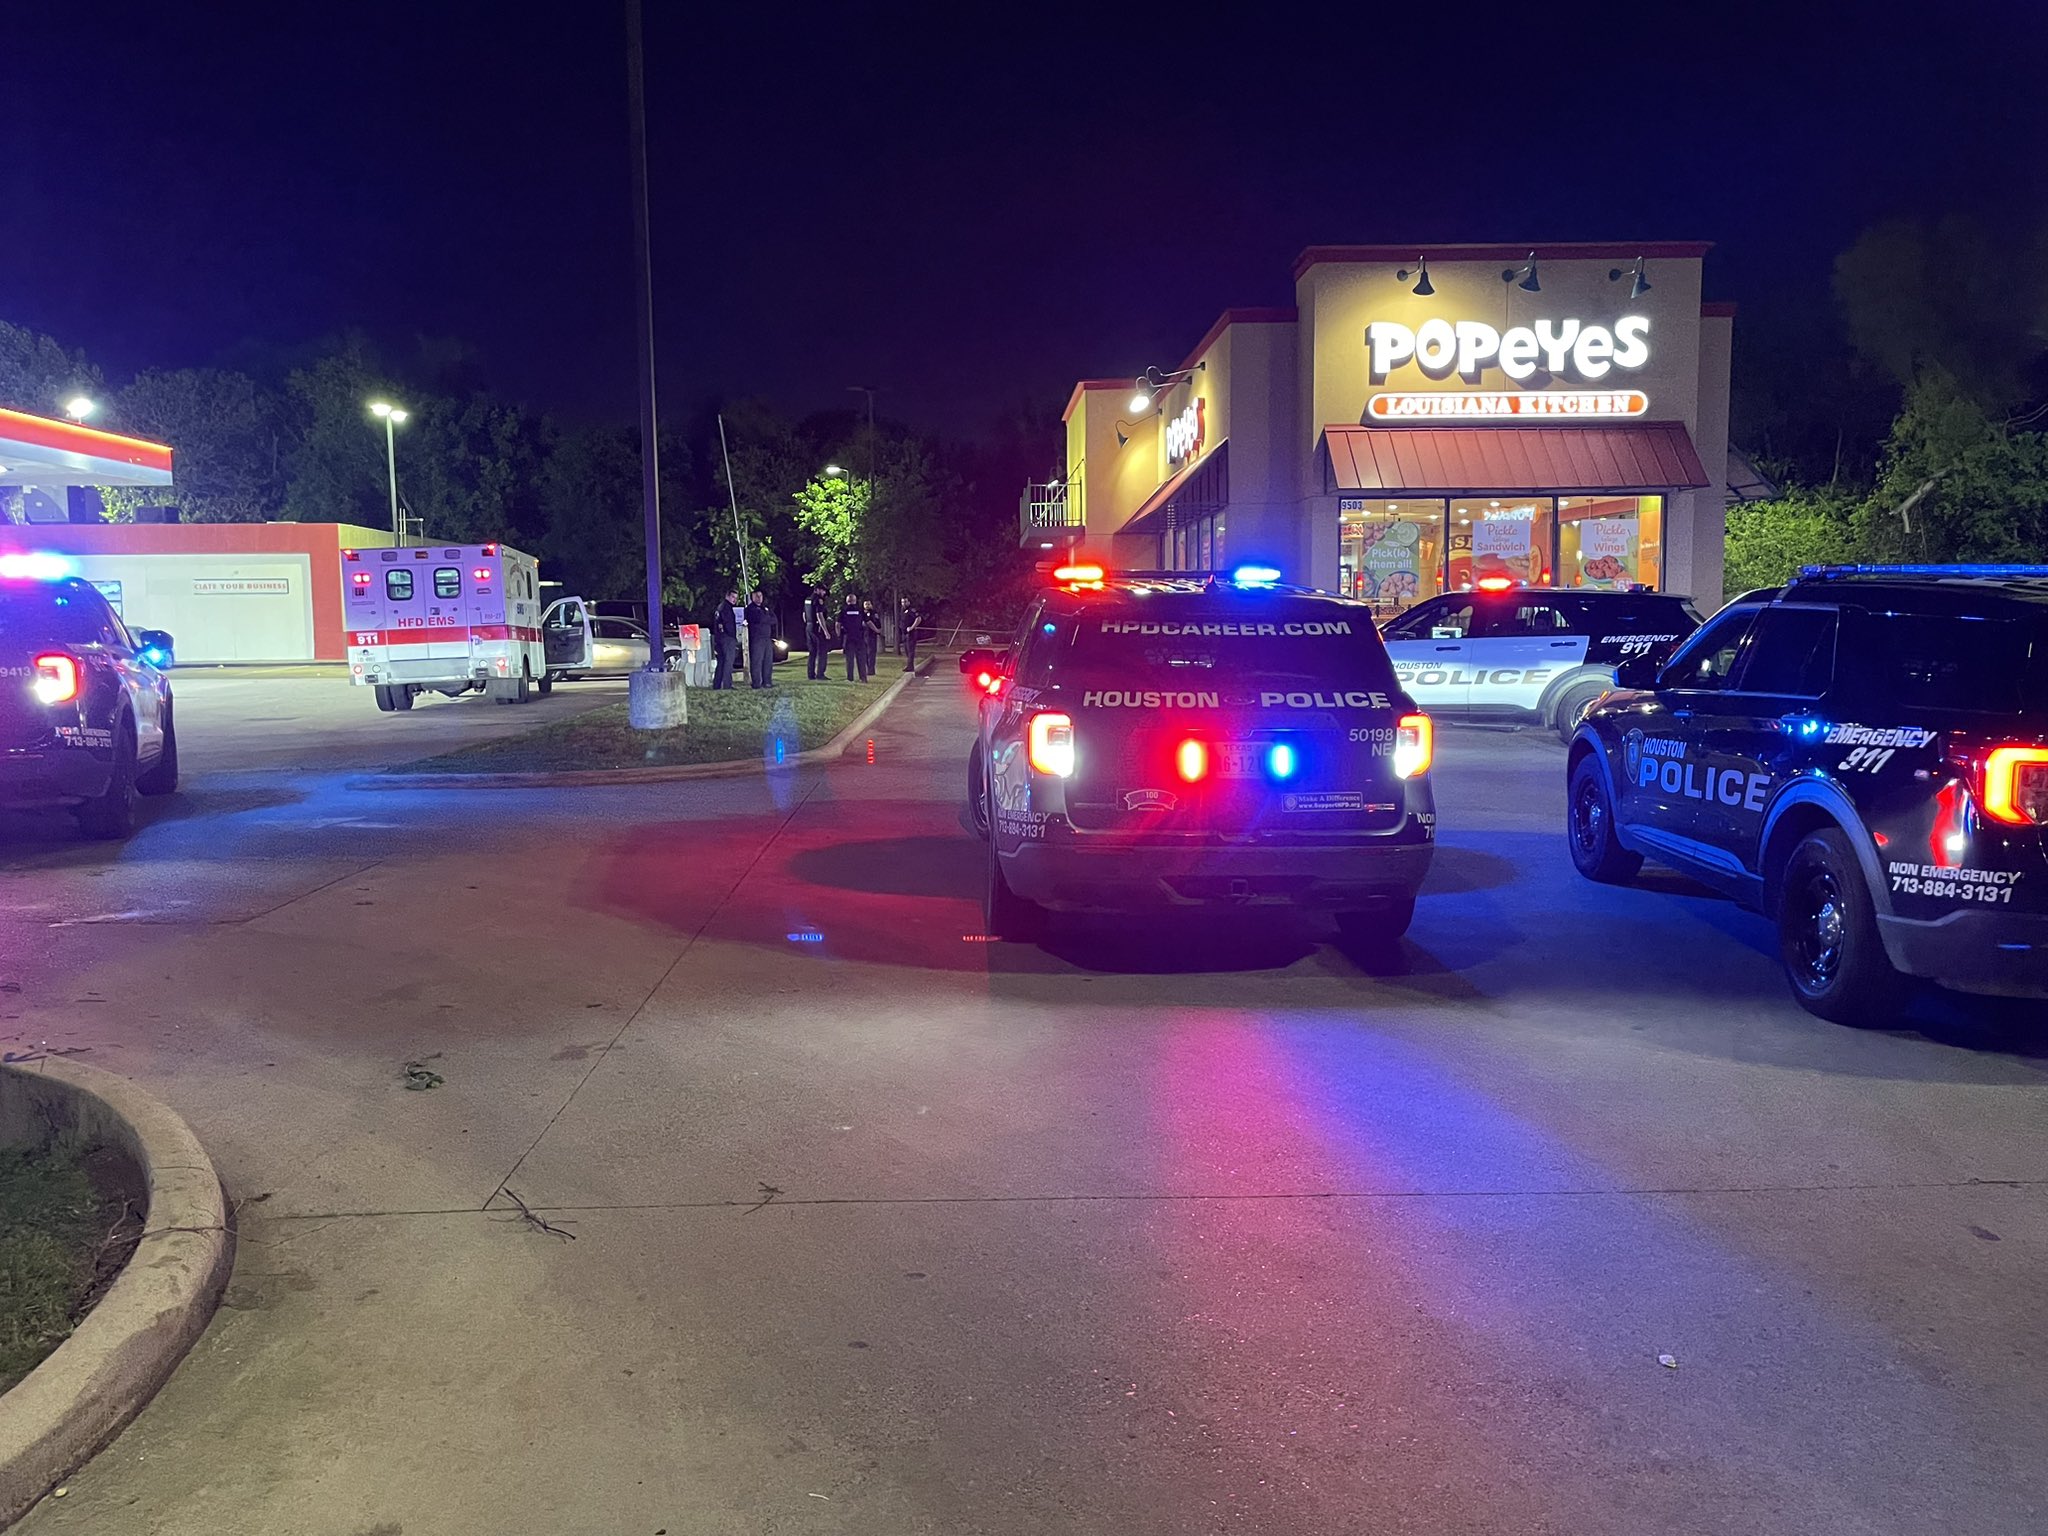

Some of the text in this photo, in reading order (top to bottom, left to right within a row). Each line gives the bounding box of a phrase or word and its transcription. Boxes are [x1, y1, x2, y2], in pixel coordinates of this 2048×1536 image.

[1386, 395, 1631, 415] LOUISIANA KITCHEN
[1341, 501, 1363, 510] 9503
[1484, 523, 1518, 536] Pickle
[1593, 522, 1626, 535] Pickle
[1477, 542, 1526, 551] Sandwich
[1594, 543, 1626, 553] Wings
[1371, 549, 1410, 558] Pick(le)
[1370, 559, 1412, 569] them all!
[398, 616, 455, 627] HFD EMS
[1101, 620, 1352, 636] HPDCAREER.COM
[357, 635, 378, 644] 911
[1601, 634, 1678, 644] EMERGENCY
[1620, 642, 1652, 654] 911
[1083, 691, 1392, 709] HOUSTON POLICE
[1349, 728, 1394, 742] 50198
[1824, 724, 1937, 748] EMERGENCY
[1371, 743, 1392, 757] NE
[1642, 737, 1687, 759] HOUSTON
[1838, 747, 1895, 774] 911
[1639, 758, 1771, 812] POLICE
[1145, 791, 1159, 799] 100
[1889, 861, 2022, 885] NON EMERGENCY
[1892, 876, 2013, 903] 713-884-3131
